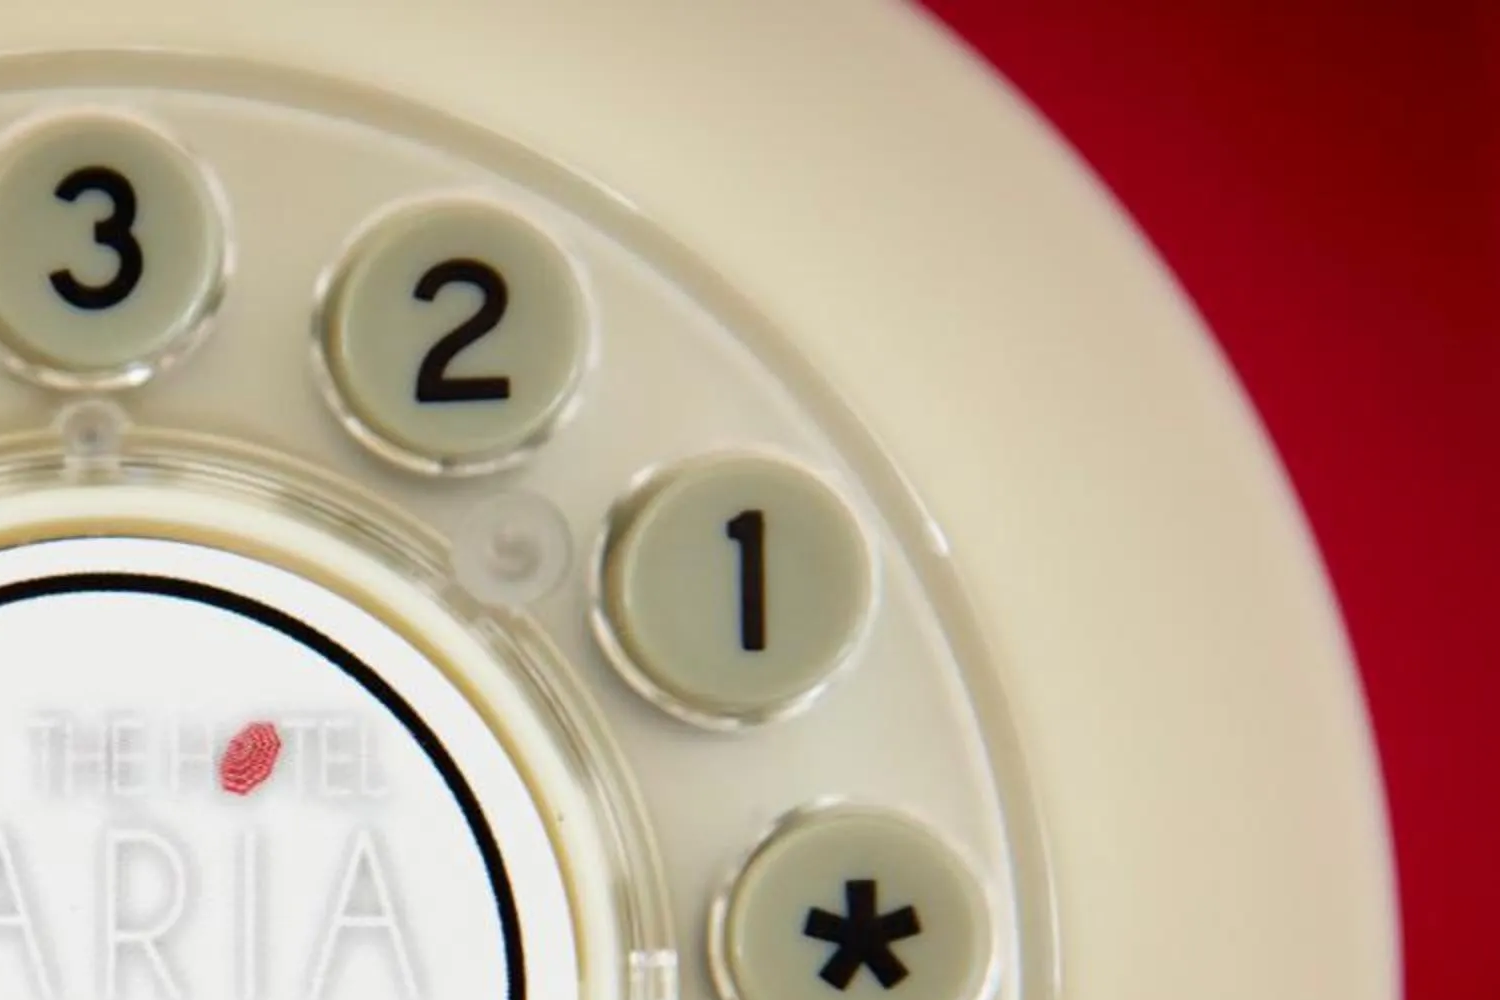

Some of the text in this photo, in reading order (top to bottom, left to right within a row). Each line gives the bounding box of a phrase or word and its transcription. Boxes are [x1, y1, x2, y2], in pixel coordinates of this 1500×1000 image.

[49, 166, 143, 310] 3
[413, 259, 510, 403] 2
[727, 511, 765, 651] 1
[25, 714, 148, 798] THE
